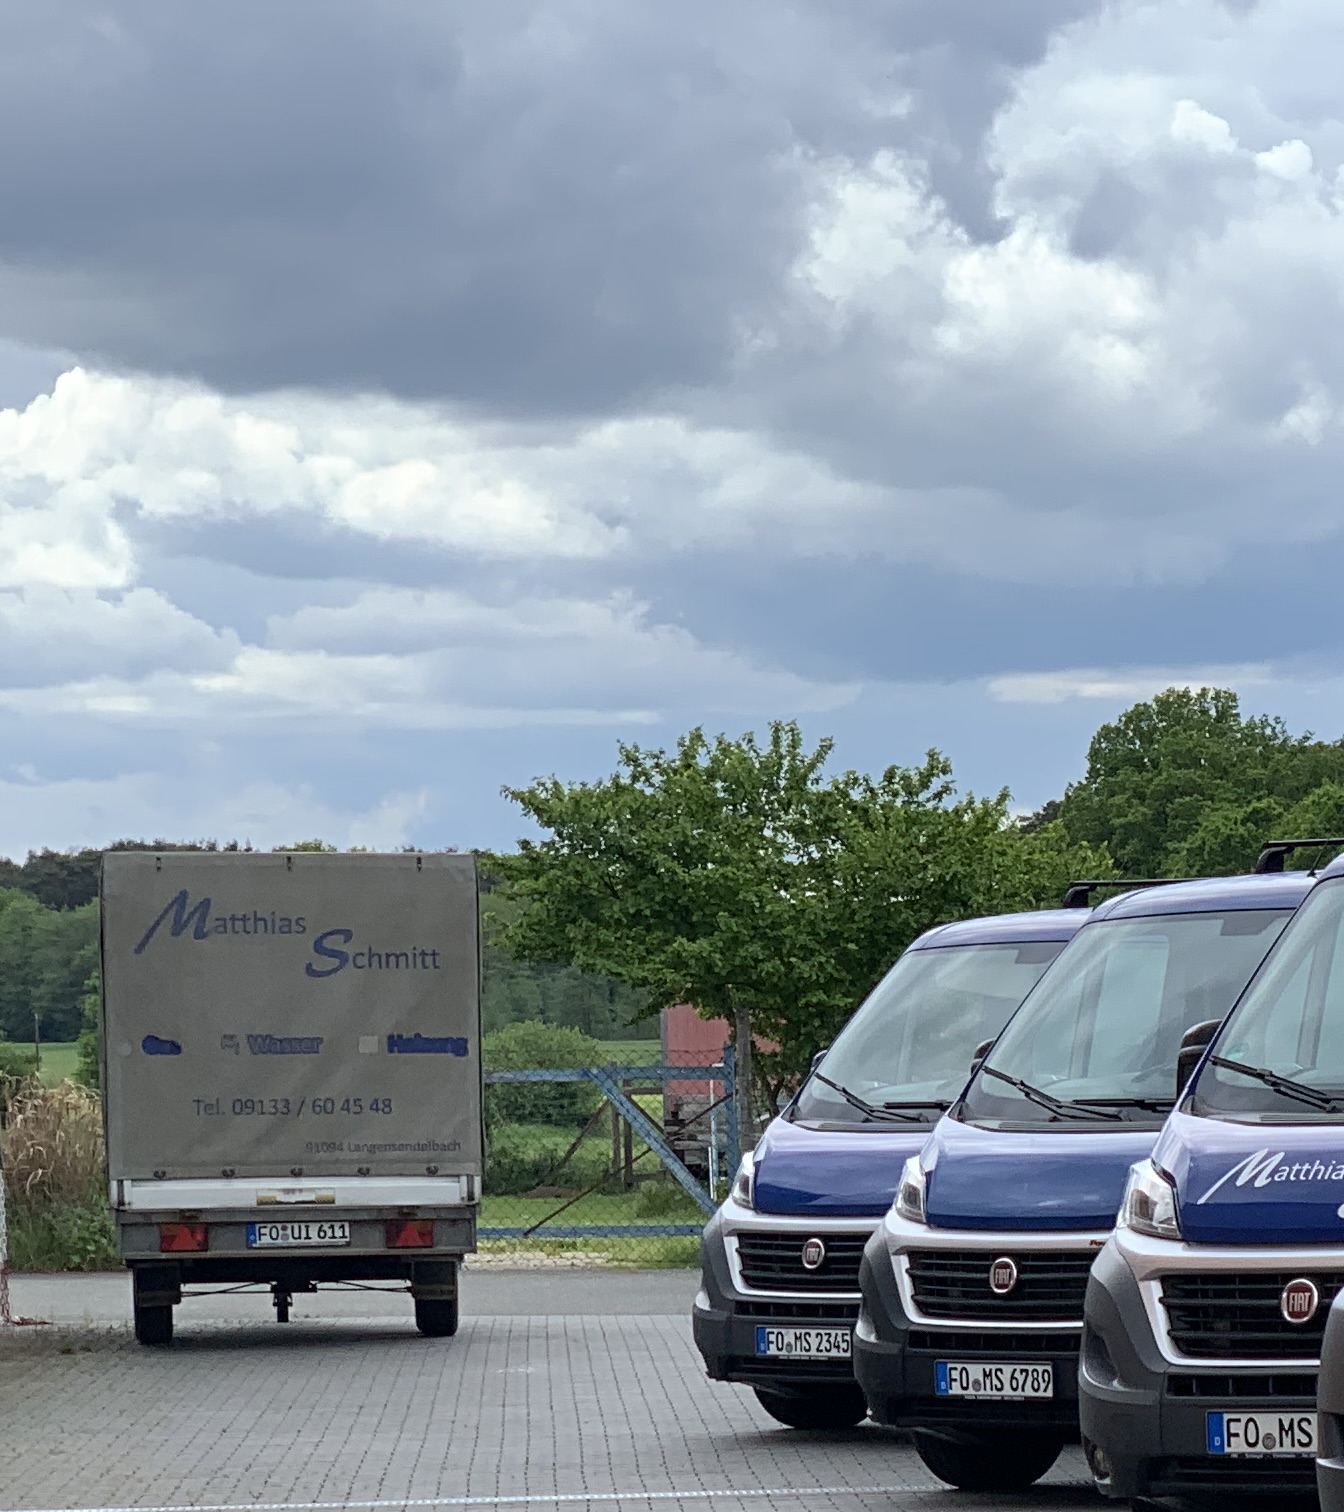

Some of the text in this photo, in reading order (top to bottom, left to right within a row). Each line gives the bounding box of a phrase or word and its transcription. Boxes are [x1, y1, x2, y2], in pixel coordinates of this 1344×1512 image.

[134, 889, 307, 954] Matthias
[305, 928, 441, 978] Schmitt
[193, 1099, 226, 1116] Tel.
[231, 1097, 291, 1115] 09133
[312, 1097, 335, 1115] 60
[340, 1097, 363, 1114] 45
[369, 1097, 393, 1114] 48
[258, 1223, 348, 1241] FO UI 611
[995, 1268, 1011, 1285] FIAT
[1288, 1292, 1311, 1312] FIAT
[767, 1331, 850, 1353] FO MS 2345
[949, 1366, 1050, 1393] FO MS 6789
[1226, 1416, 1313, 1448] FO MS
